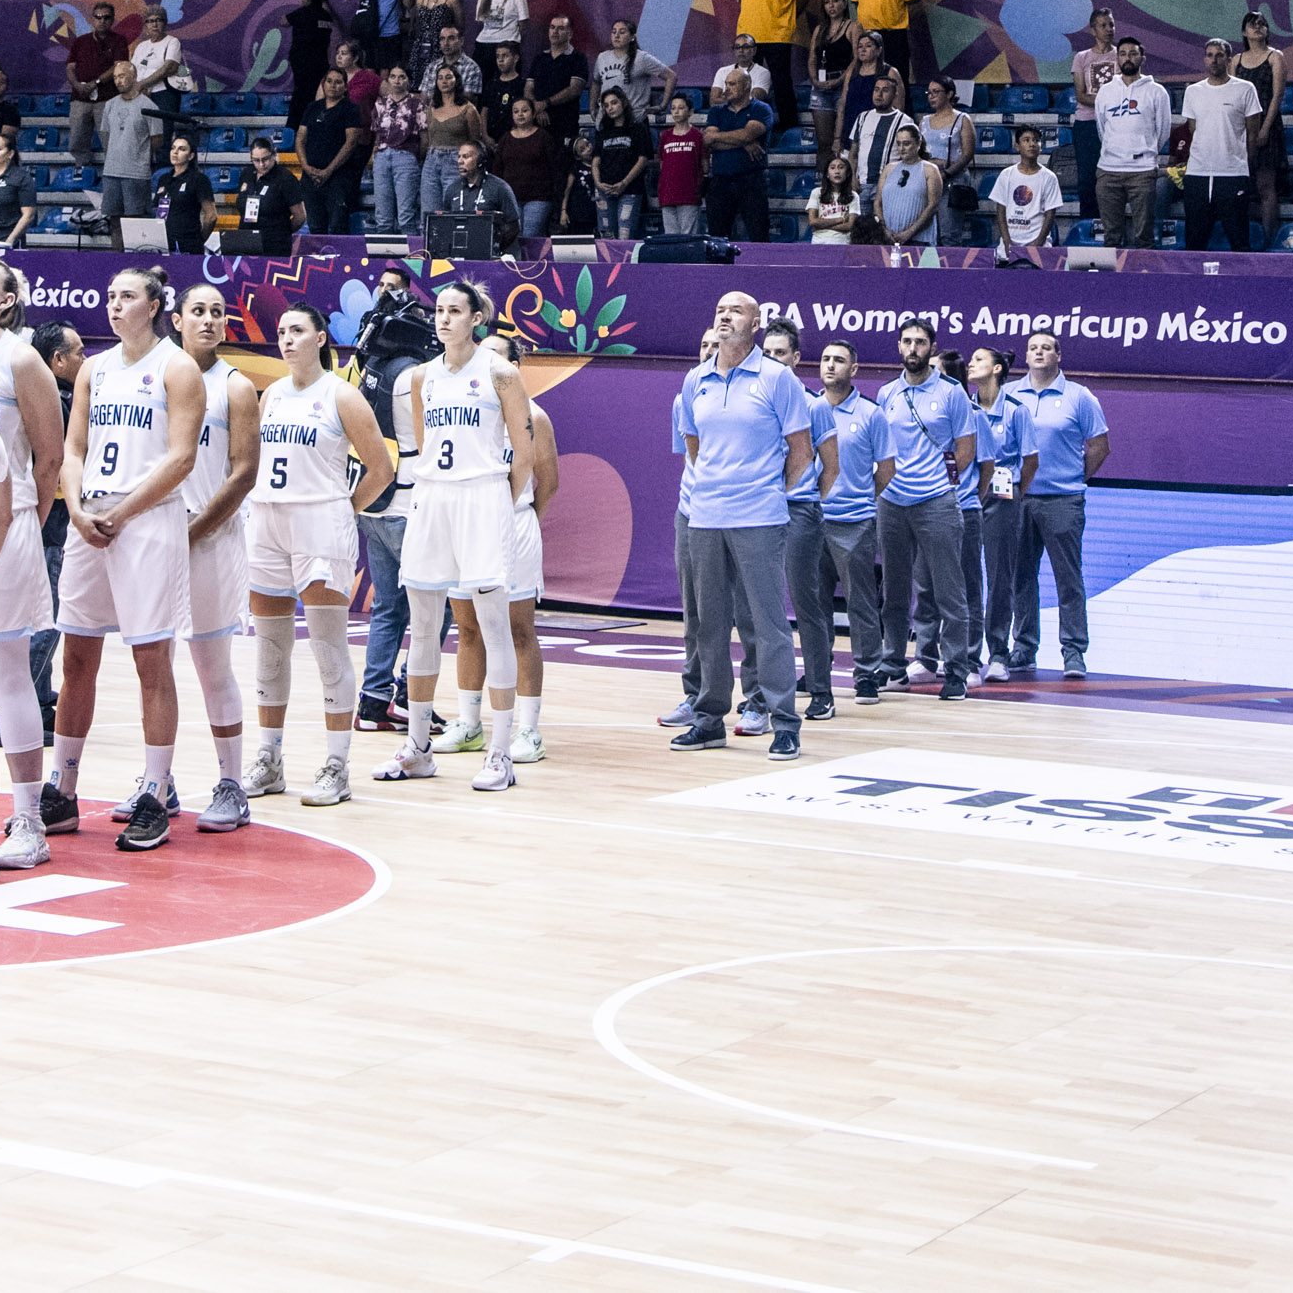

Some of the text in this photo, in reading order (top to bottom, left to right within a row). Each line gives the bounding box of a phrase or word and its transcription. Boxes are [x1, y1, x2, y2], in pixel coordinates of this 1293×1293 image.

[813, 303, 963, 335] Women's
[971, 306, 1149, 347] Americup
[1156, 305, 1287, 345] México
[89, 404, 153, 430] ARGENTINA
[424, 406, 480, 428] ARGENTINA
[260, 424, 317, 448] RGENTINA
[100, 442, 119, 476] 9
[438, 439, 454, 470] 3
[270, 458, 288, 489] 5
[745, 791, 927, 815] SWISS
[961, 812, 1238, 848] WATCHES
